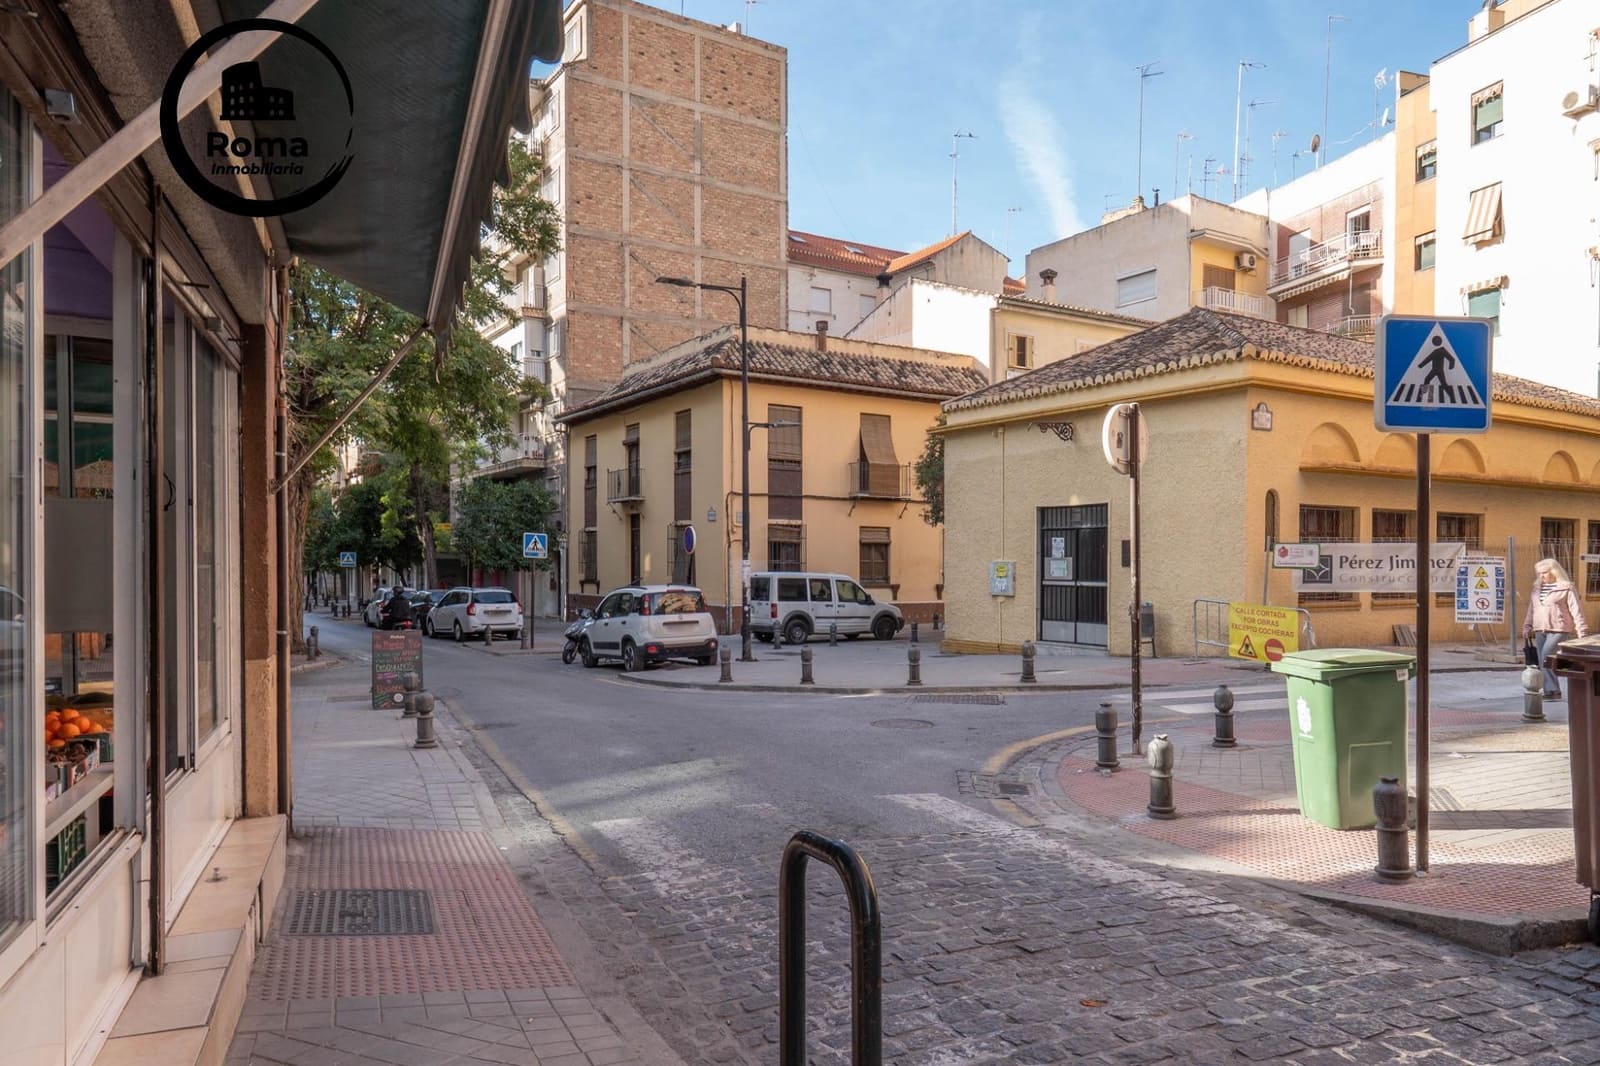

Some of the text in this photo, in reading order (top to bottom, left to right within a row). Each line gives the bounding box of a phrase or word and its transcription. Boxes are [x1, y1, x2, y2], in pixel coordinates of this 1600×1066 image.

[1339, 555, 1454, 571] Pérez Jimnez
[1339, 573, 1455, 585] Construccnes
[1235, 607, 1287, 618] CALLE CORTADA
[1257, 618, 1279, 626] OBRAS
[1259, 627, 1295, 638] COCHERAS
